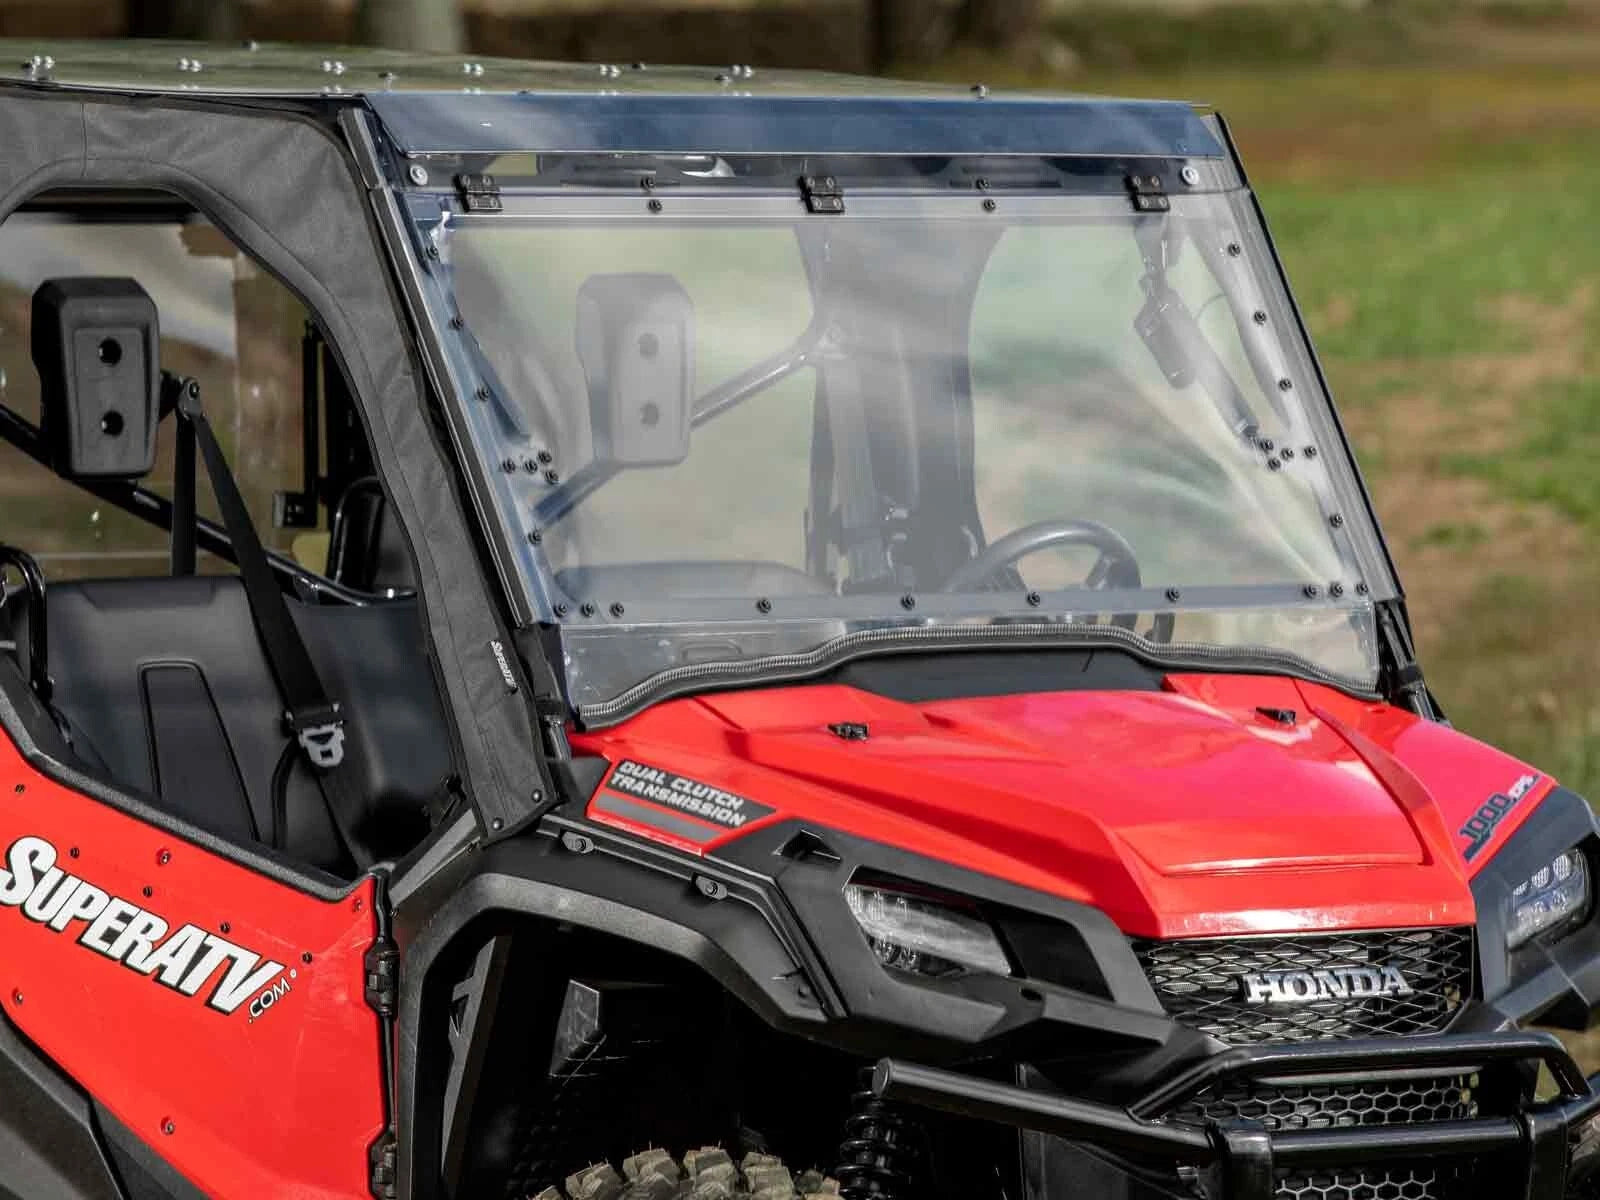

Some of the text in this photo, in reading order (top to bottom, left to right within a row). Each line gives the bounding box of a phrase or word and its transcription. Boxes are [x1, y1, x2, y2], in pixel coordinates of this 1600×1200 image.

[611, 772, 746, 826] TRANSMISSION
[619, 761, 744, 810] DUAL CLUTCH
[1459, 793, 1511, 843] 1000
[1246, 966, 1413, 1002] HONDA
